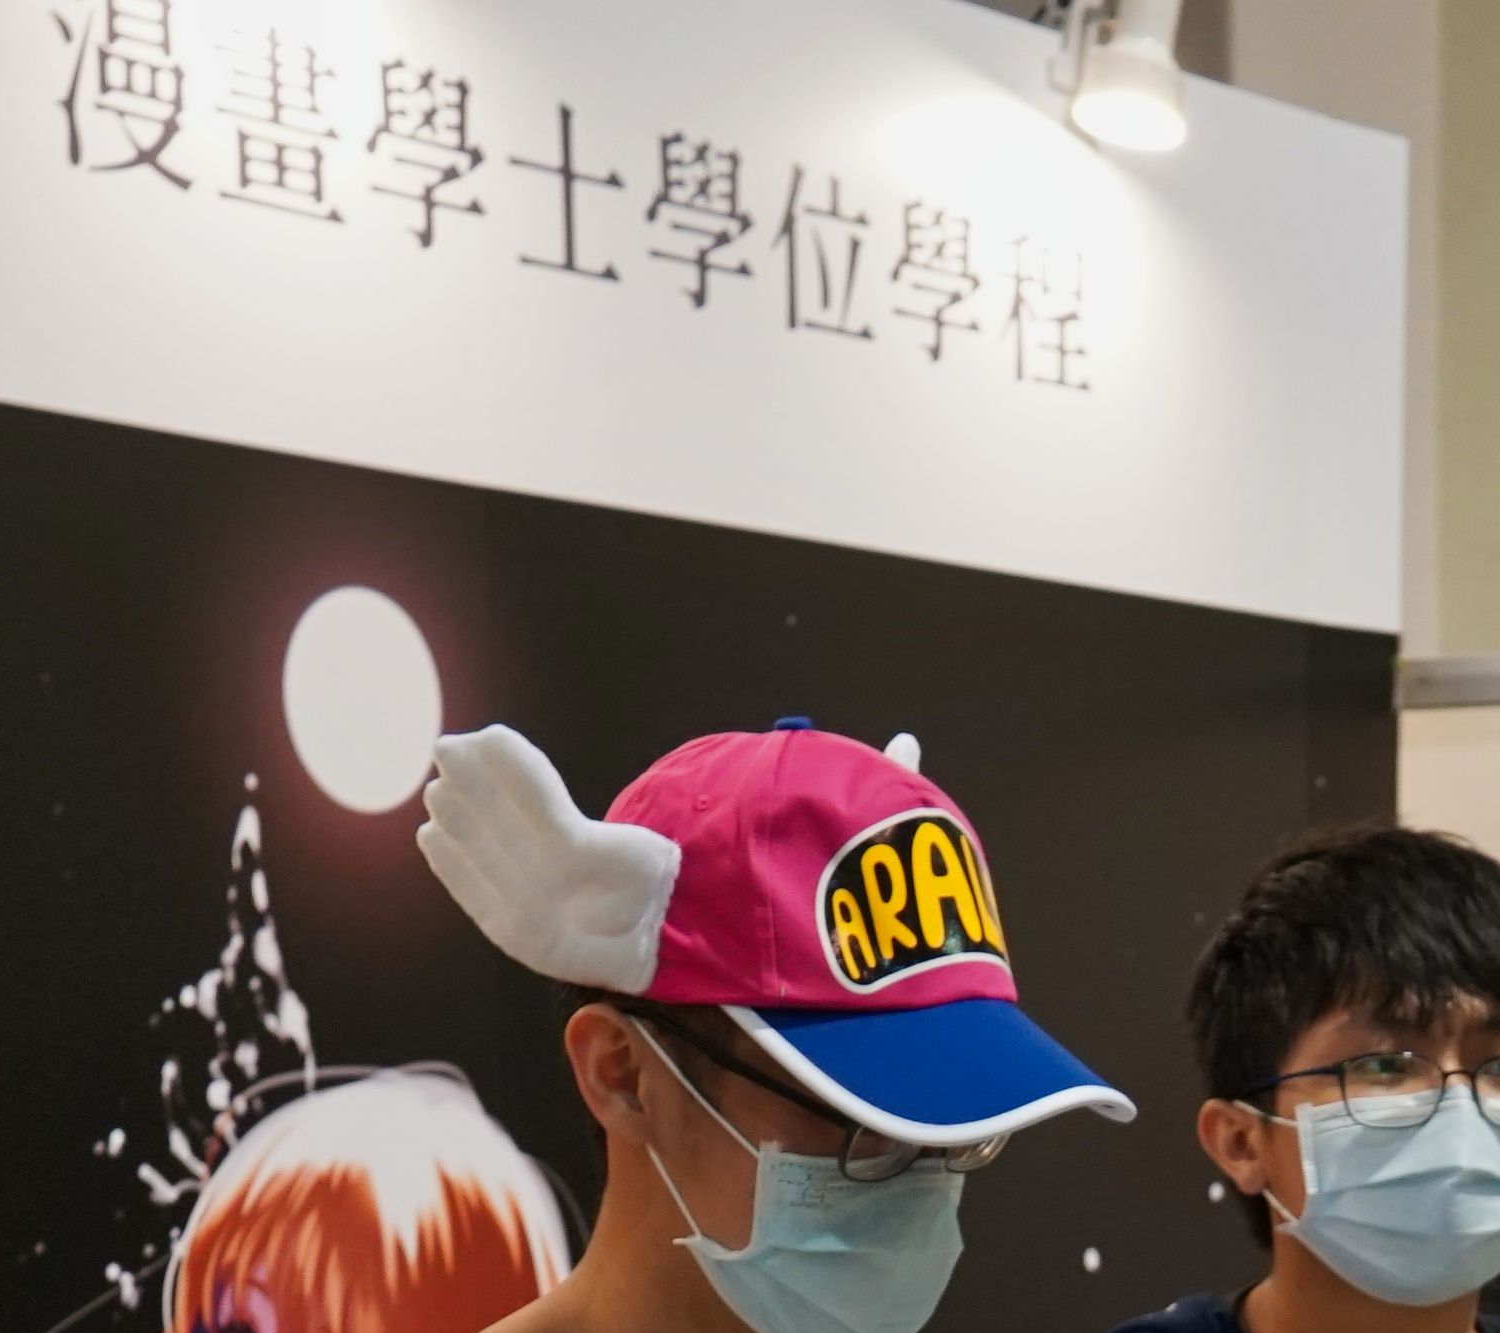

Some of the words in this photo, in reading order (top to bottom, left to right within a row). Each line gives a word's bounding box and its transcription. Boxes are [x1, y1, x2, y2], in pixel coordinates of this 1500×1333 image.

[47, 0, 1092, 393] 漫畫學士學位學程
